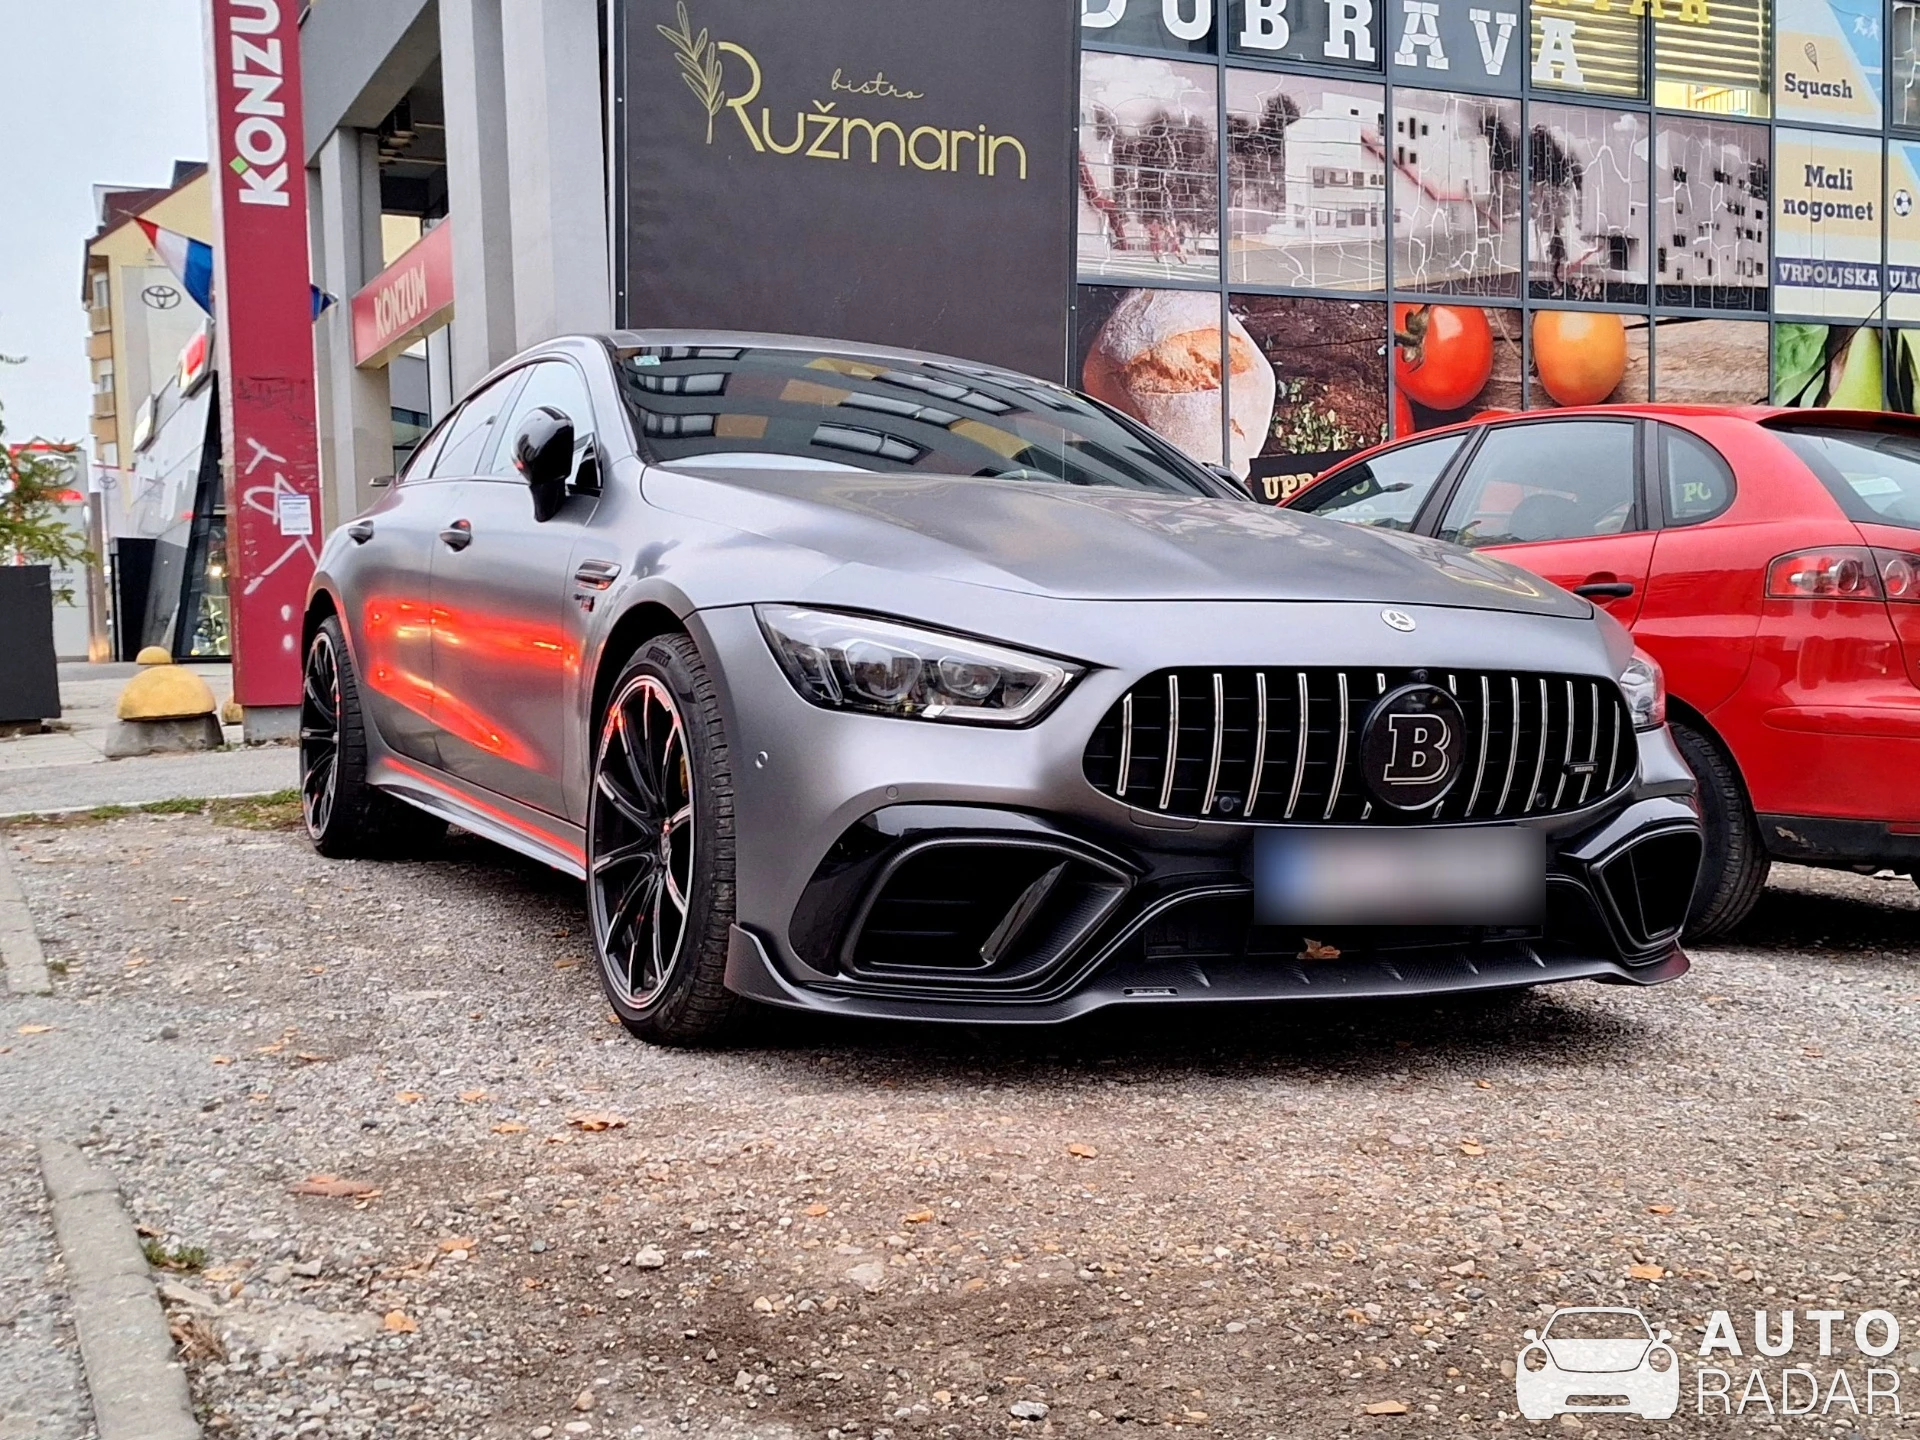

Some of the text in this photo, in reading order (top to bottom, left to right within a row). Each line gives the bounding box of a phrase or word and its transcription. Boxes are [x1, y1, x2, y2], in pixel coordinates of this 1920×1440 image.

[831, 68, 924, 99] bistro
[1784, 72, 1853, 99] Squash
[718, 41, 1027, 179] Ružmarin
[1804, 164, 1854, 191] Mali
[1783, 198, 1874, 222] nogomet
[1779, 262, 1920, 289] VRPOLJSKA ULI
[374, 260, 428, 341] KONZUM
[1383, 714, 1451, 785] B
